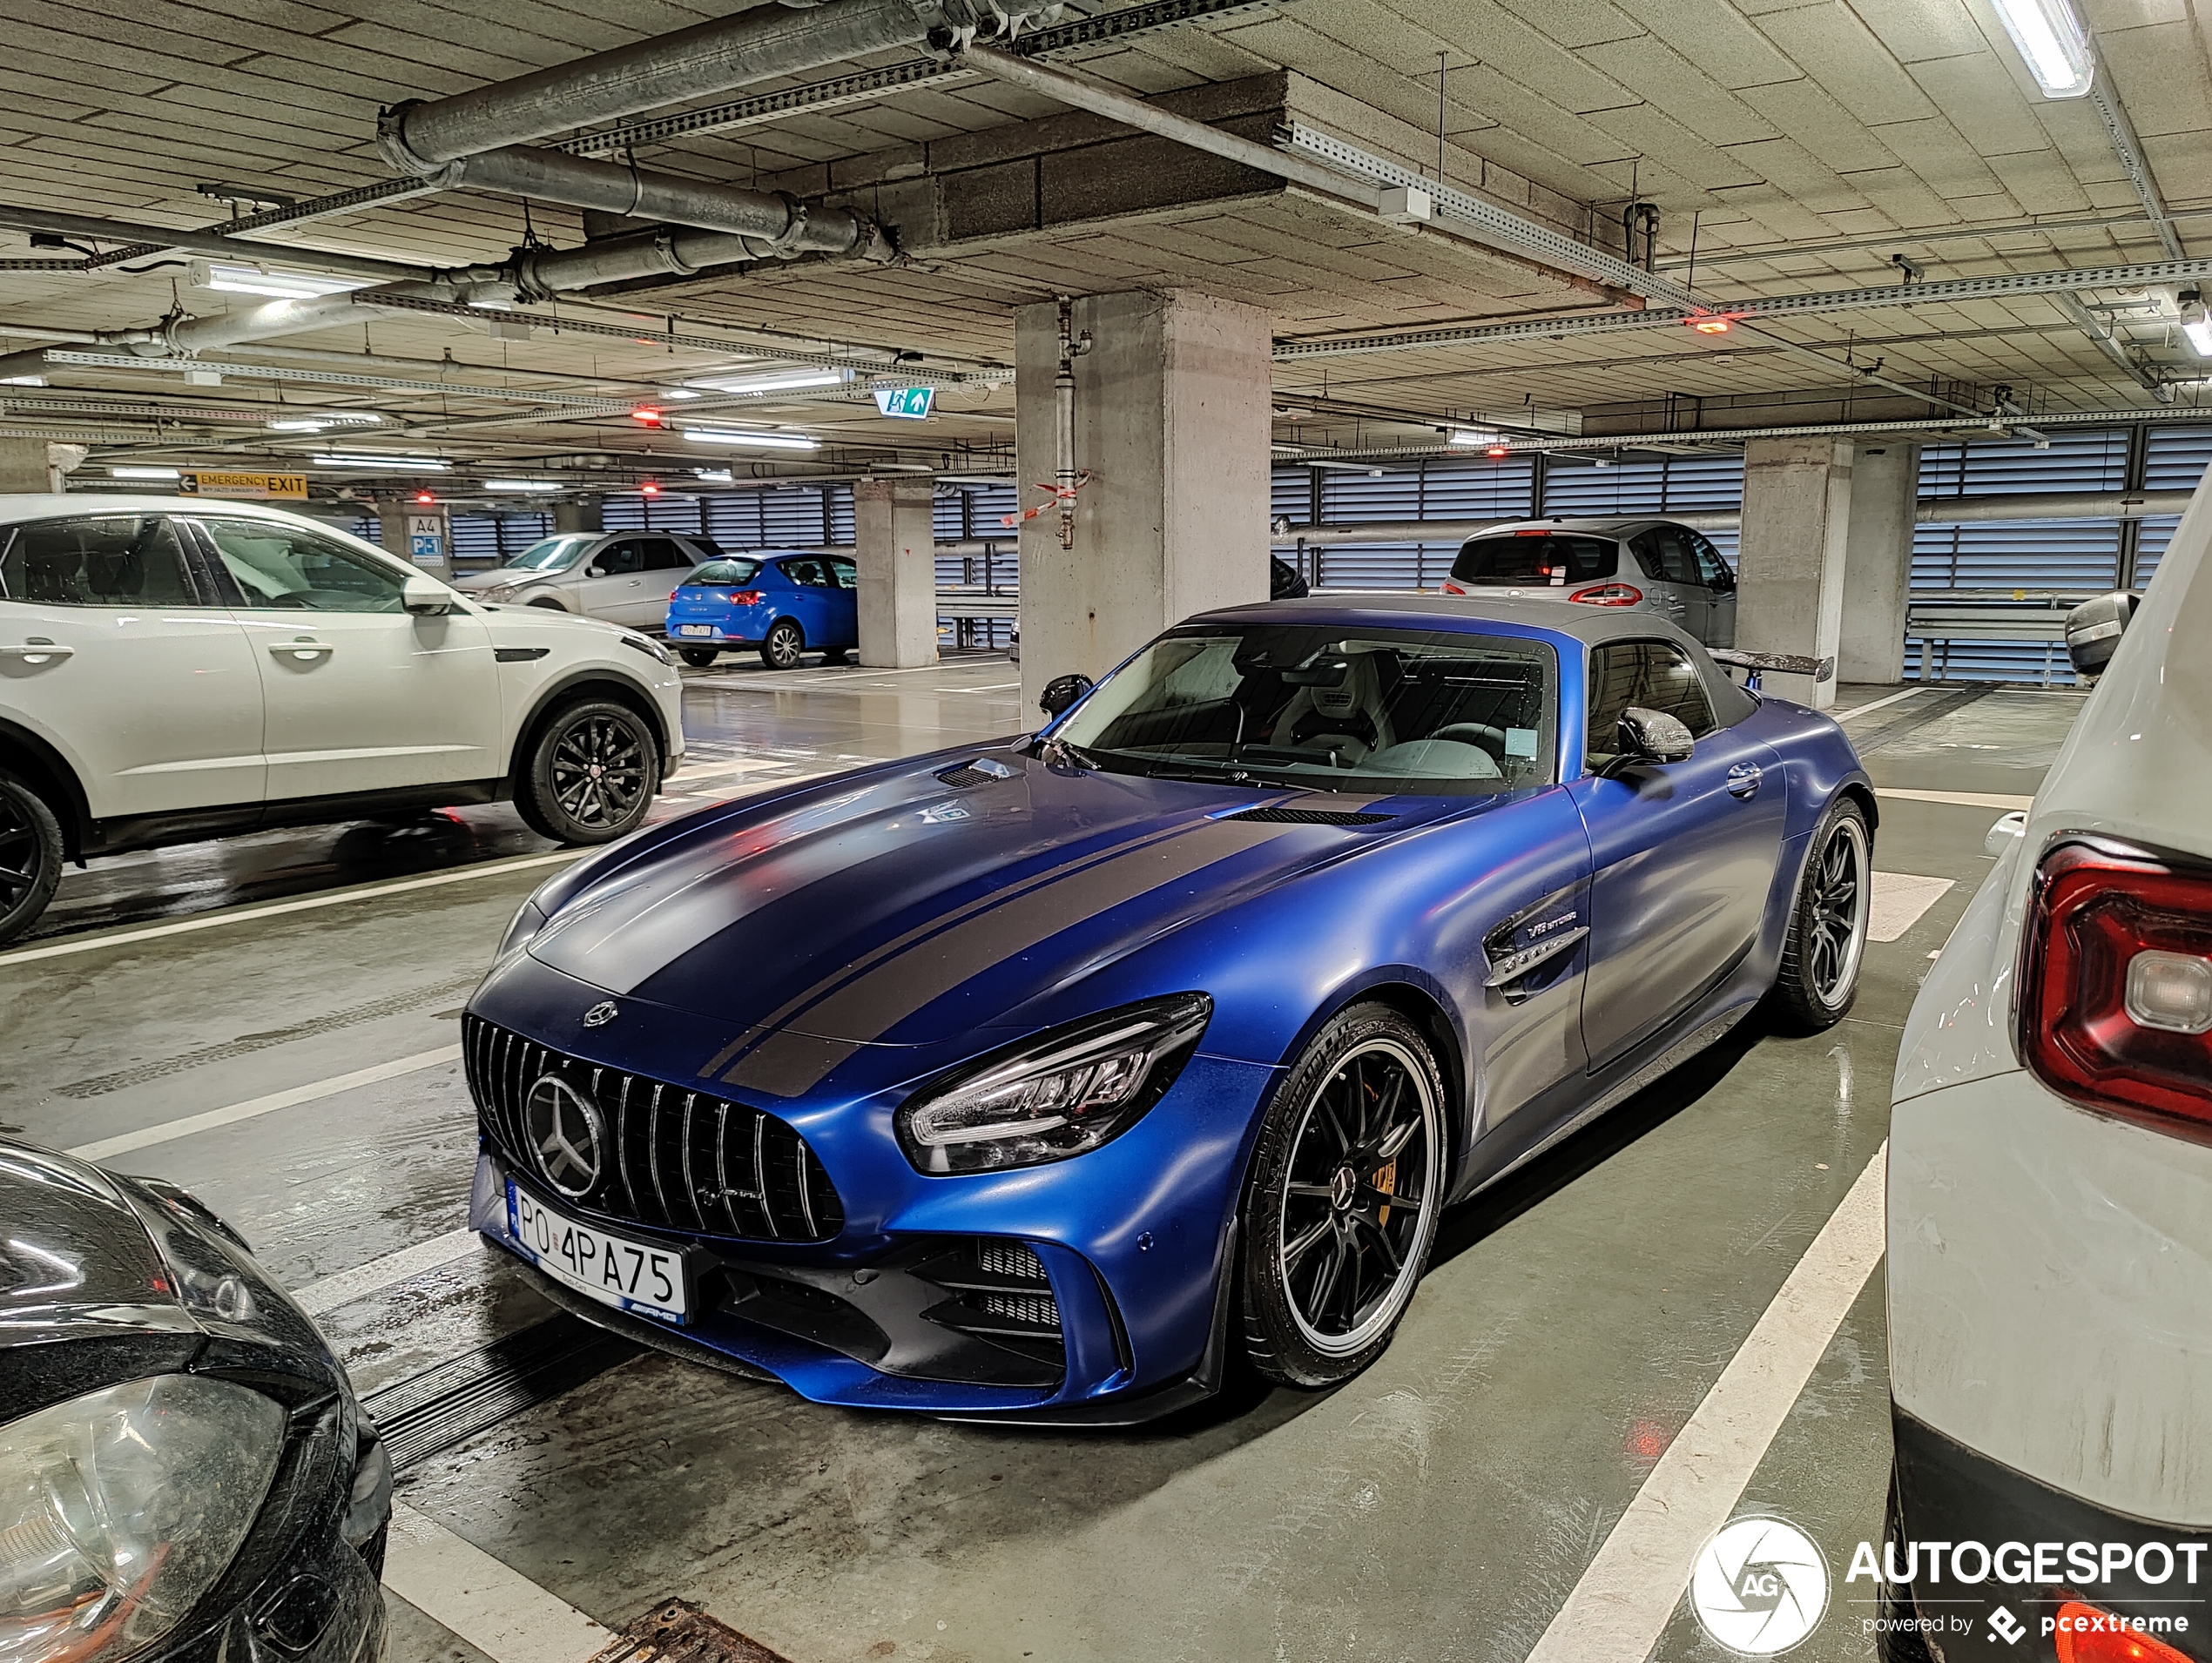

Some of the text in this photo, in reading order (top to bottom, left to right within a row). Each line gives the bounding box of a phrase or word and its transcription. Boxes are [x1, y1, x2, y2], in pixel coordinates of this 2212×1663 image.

[201, 475, 303, 492] EMERGENCY EXIT
[416, 519, 435, 533] A4
[521, 1195, 550, 1254] PO
